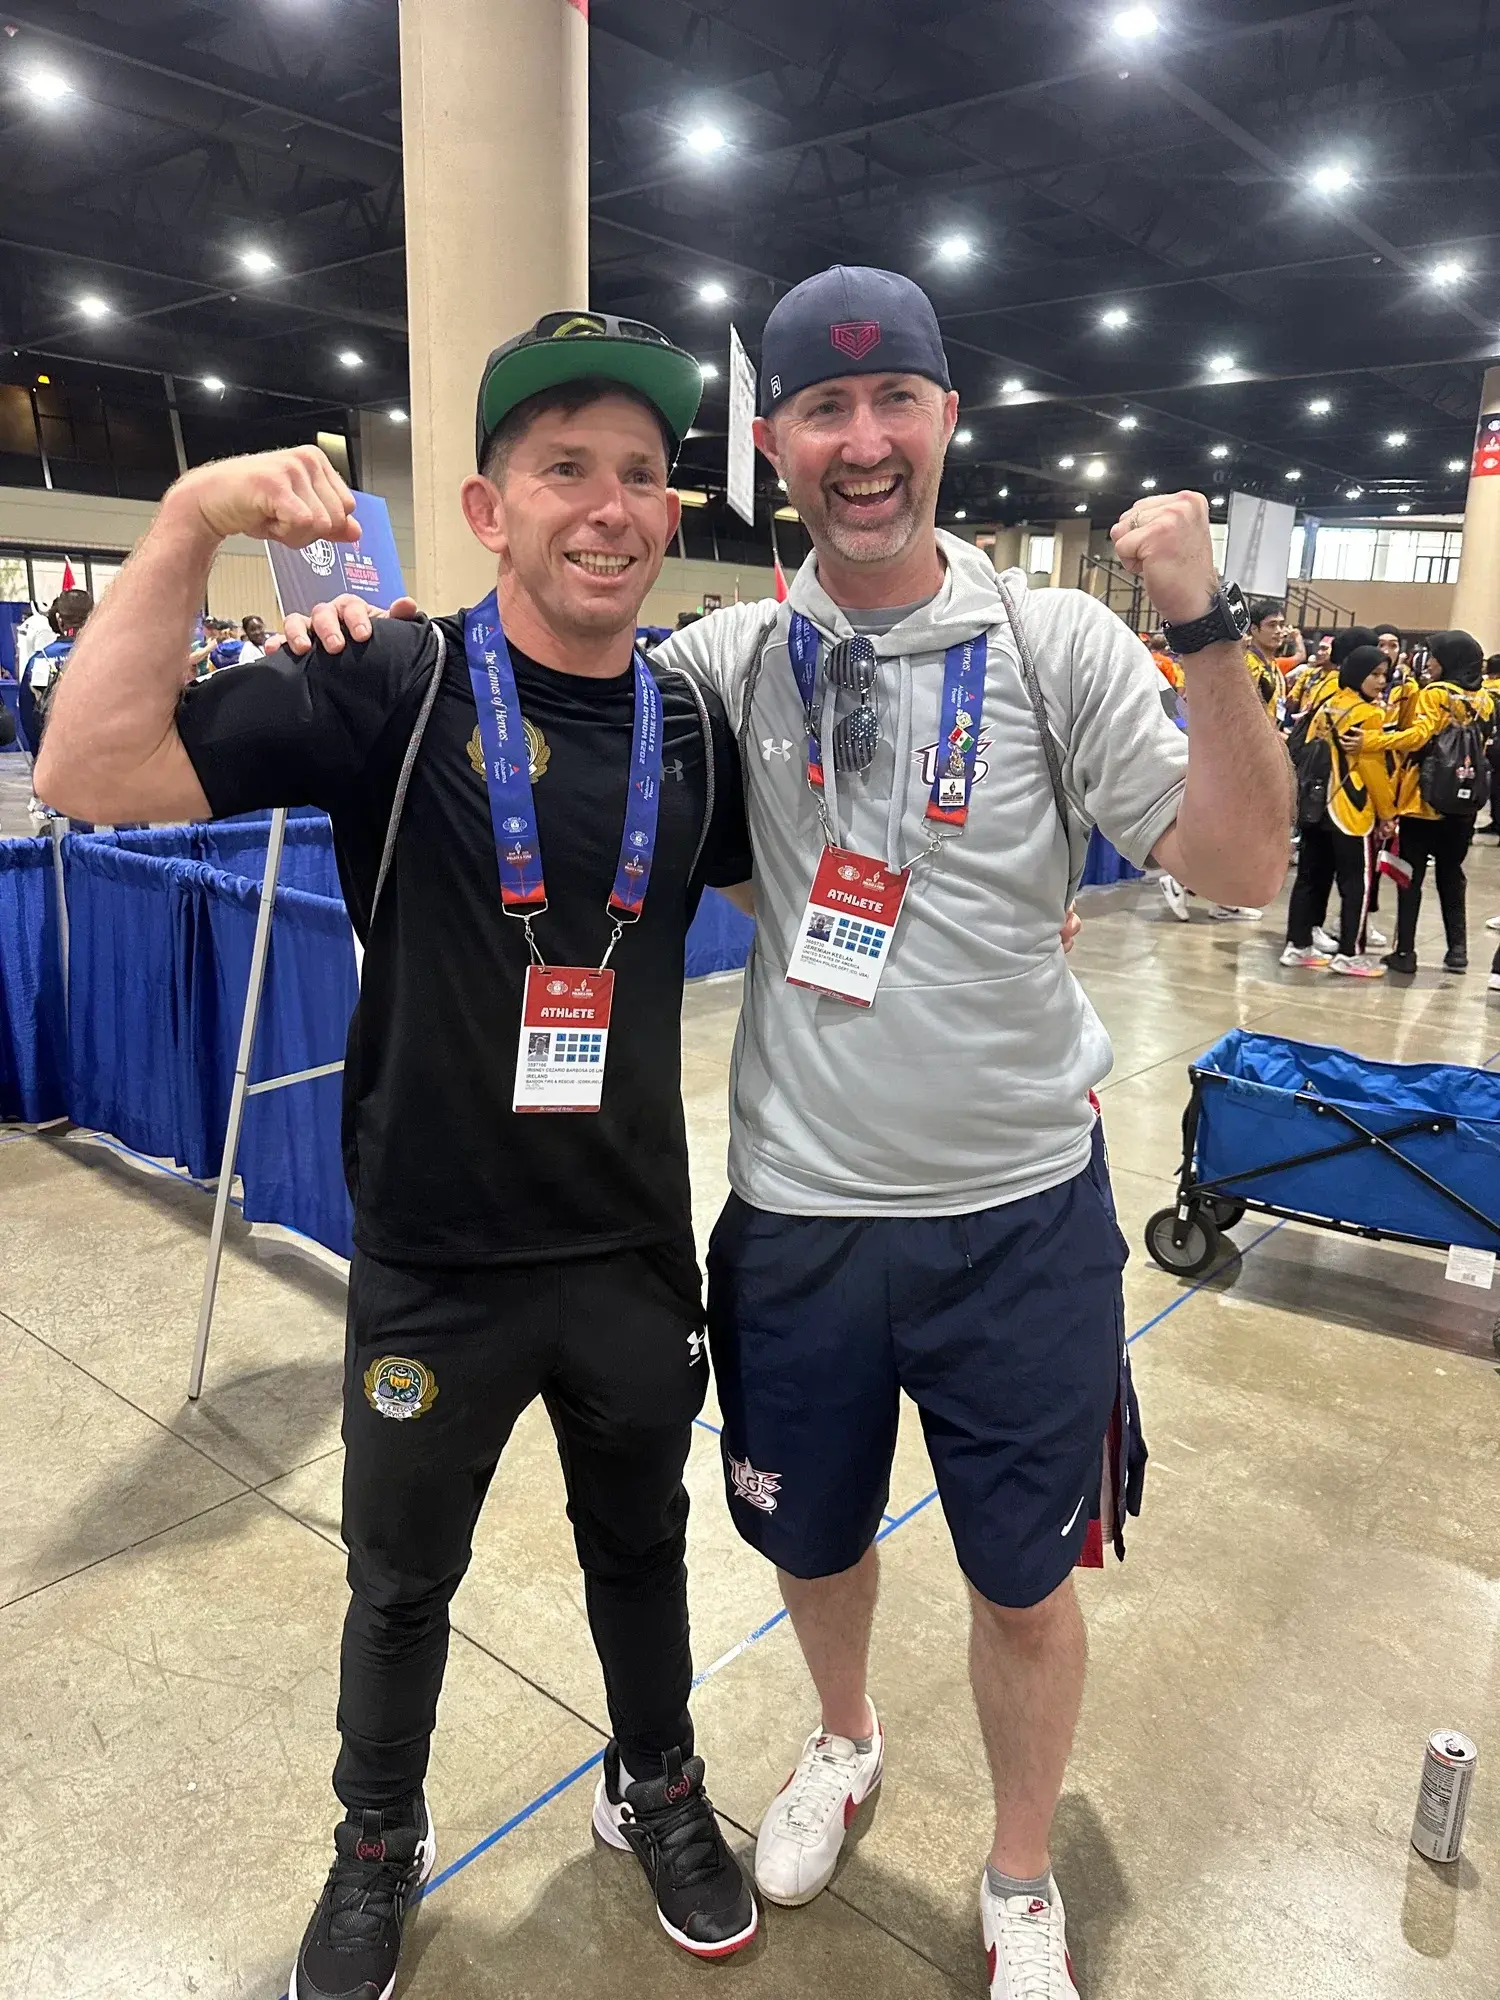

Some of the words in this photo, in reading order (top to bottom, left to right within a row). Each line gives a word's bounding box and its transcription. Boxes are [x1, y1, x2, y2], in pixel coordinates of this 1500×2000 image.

[311, 563, 332, 576] GAMES
[485, 650, 497, 665] The
[487, 666, 500, 695] Games
[649, 688, 657, 721] GAMES
[495, 707, 509, 741] Heroes
[641, 705, 650, 740] WORLD
[648, 721, 657, 742] FIRE
[499, 756, 507, 784] Alabama
[827, 888, 883, 913] ATHLETE
[804, 944, 831, 955] JEREMIAH
[831, 951, 853, 962] KEELAN
[540, 1007, 595, 1019] ATHLETE
[392, 1404, 417, 1413] RESCUE
